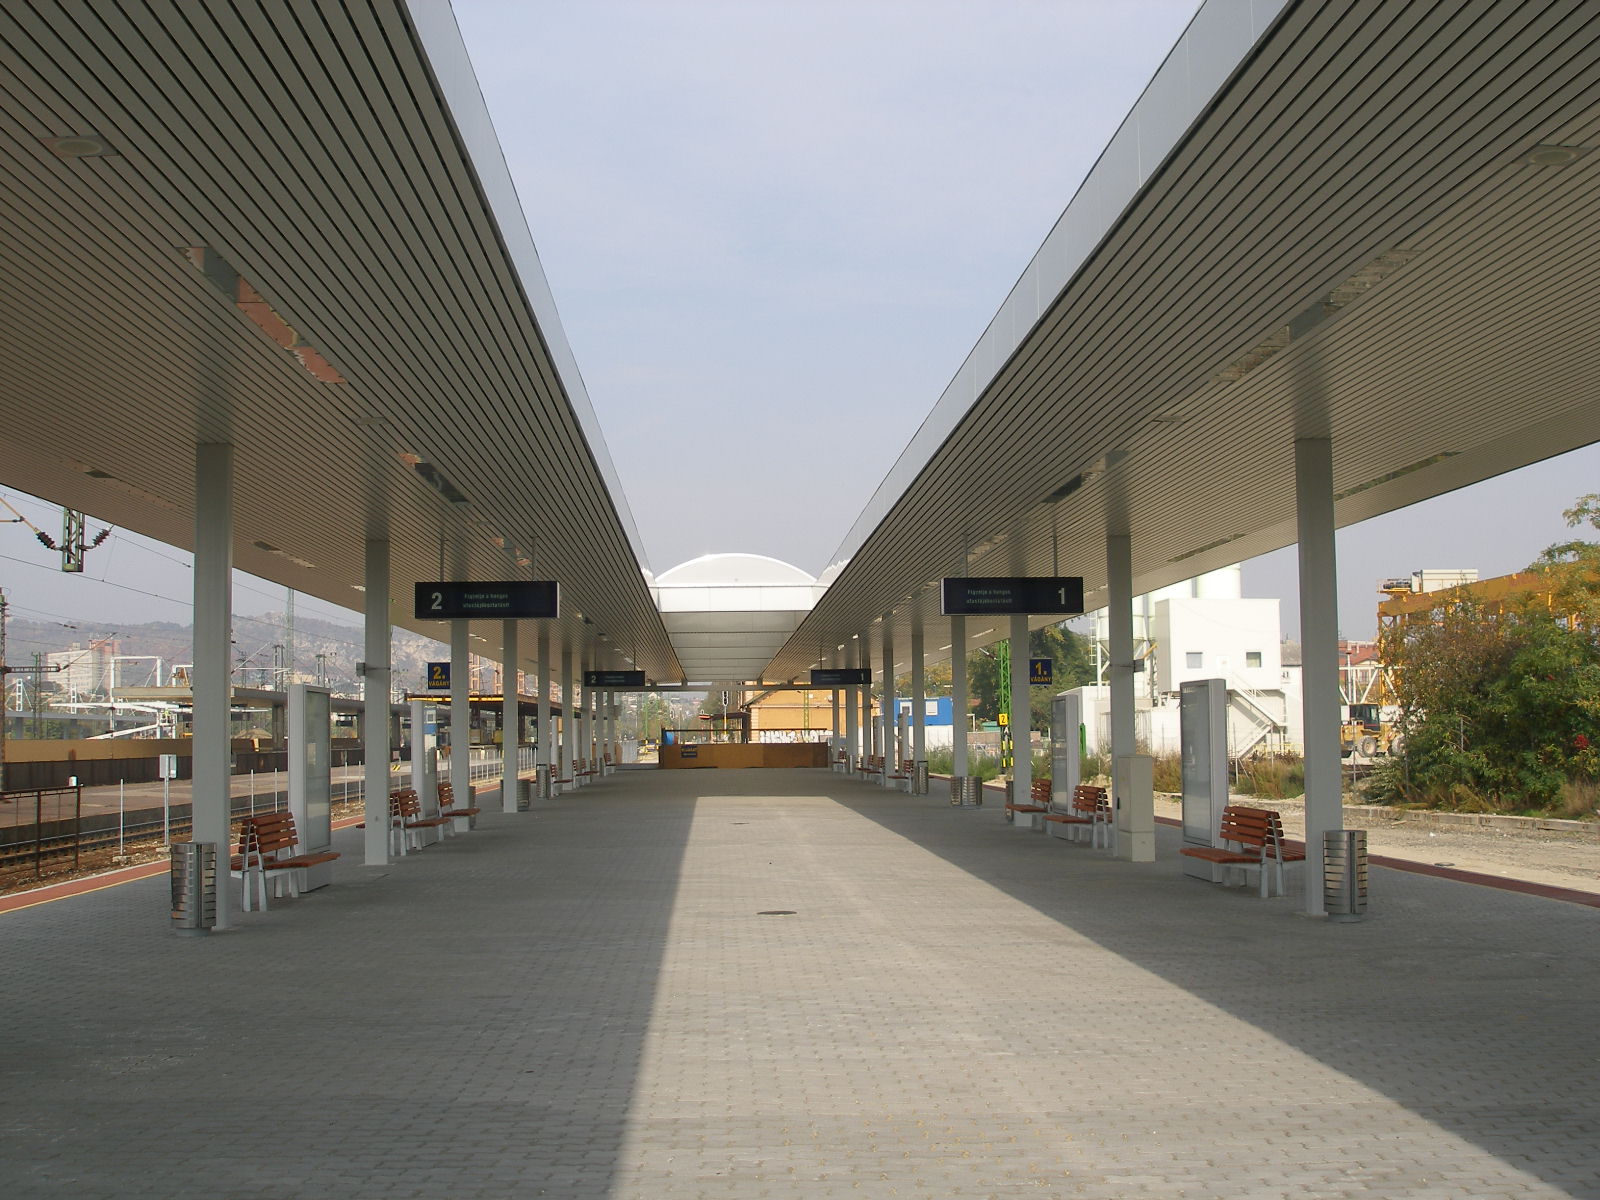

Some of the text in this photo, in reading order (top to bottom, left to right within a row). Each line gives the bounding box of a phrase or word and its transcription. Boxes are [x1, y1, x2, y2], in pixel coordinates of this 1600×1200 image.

[431, 592, 443, 610] 2
[1058, 587, 1065, 605] 1
[432, 666, 446, 680] 2.
[1035, 662, 1048, 675] 1.
[591, 675, 597, 683] 2
[1000, 714, 1006, 723] 2
